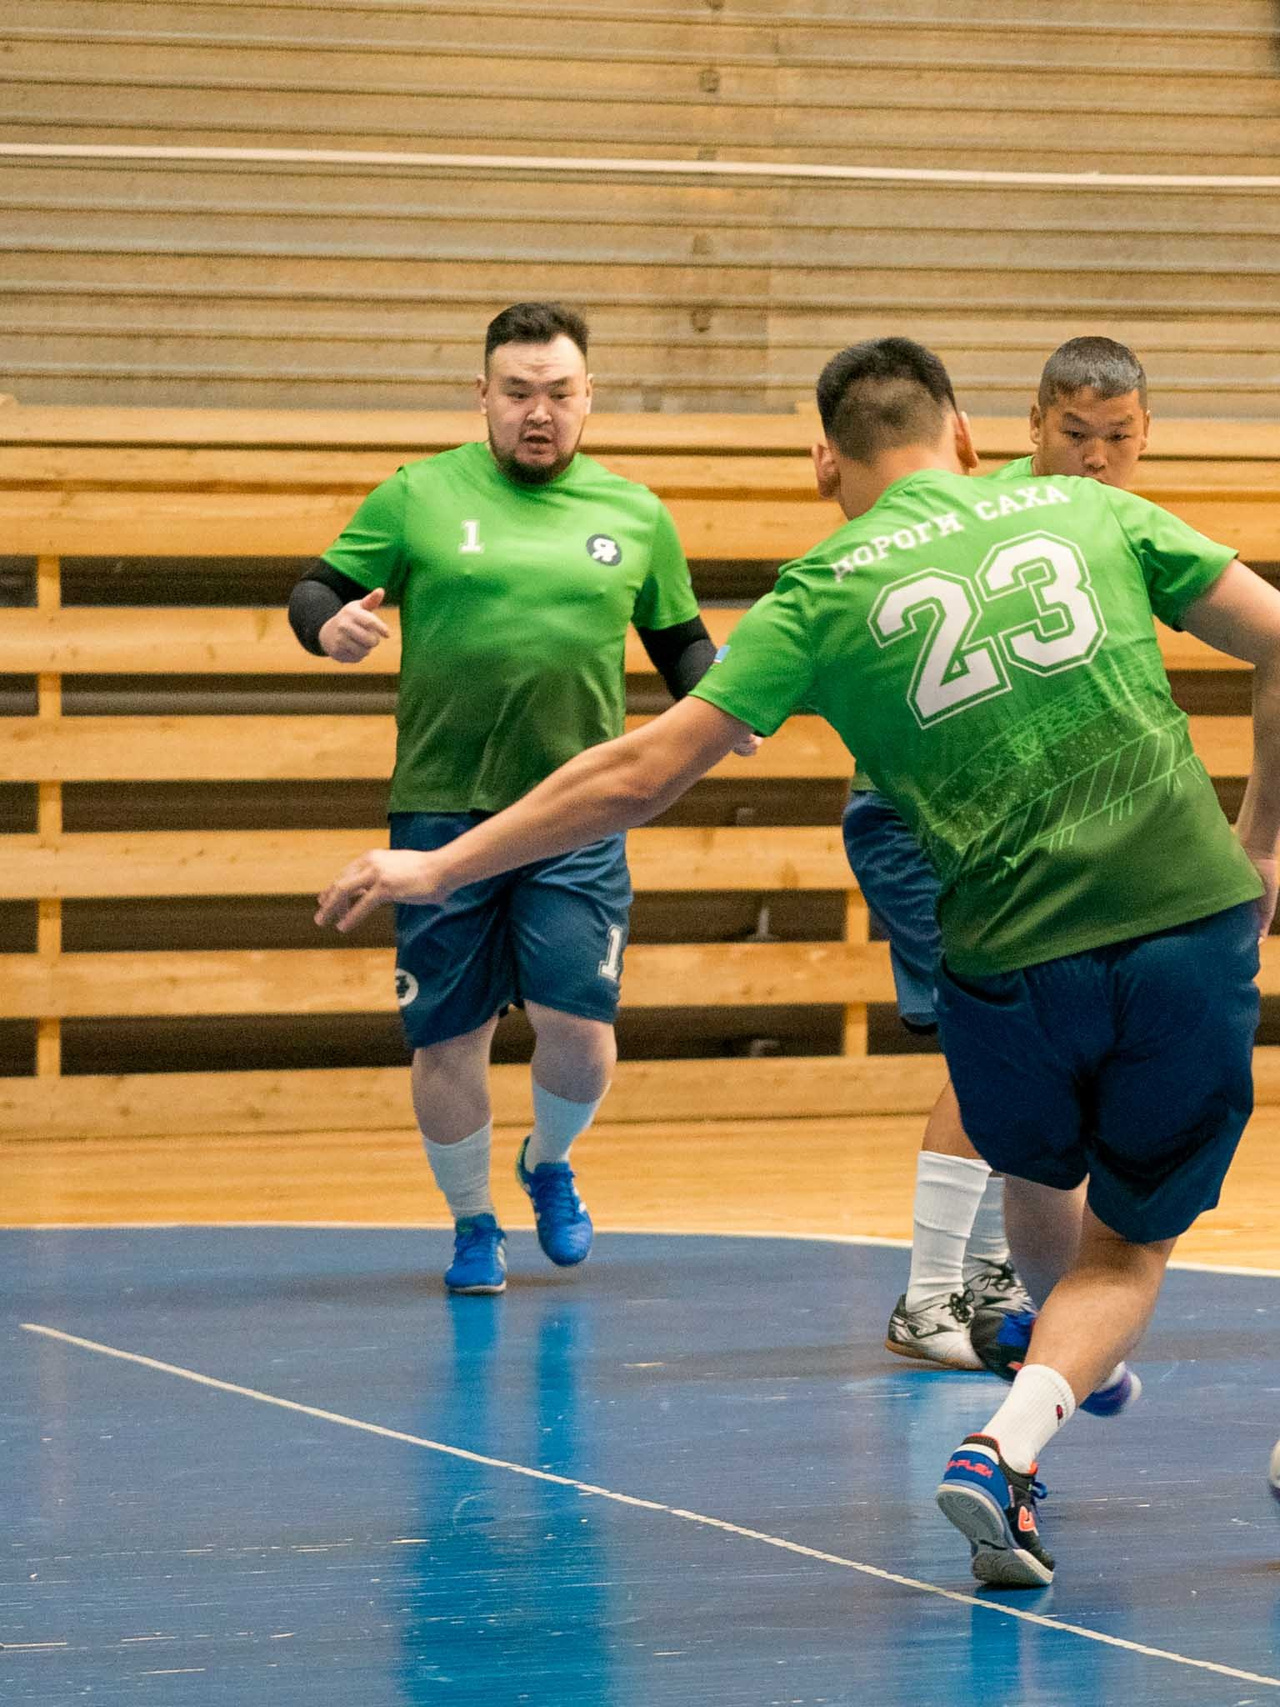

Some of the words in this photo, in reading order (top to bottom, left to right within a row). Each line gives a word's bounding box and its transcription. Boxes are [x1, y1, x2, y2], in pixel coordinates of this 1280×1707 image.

[974, 484, 1071, 521] САХА
[458, 518, 486, 554] 1
[867, 529, 1107, 730] 23
[598, 923, 624, 982] 1
